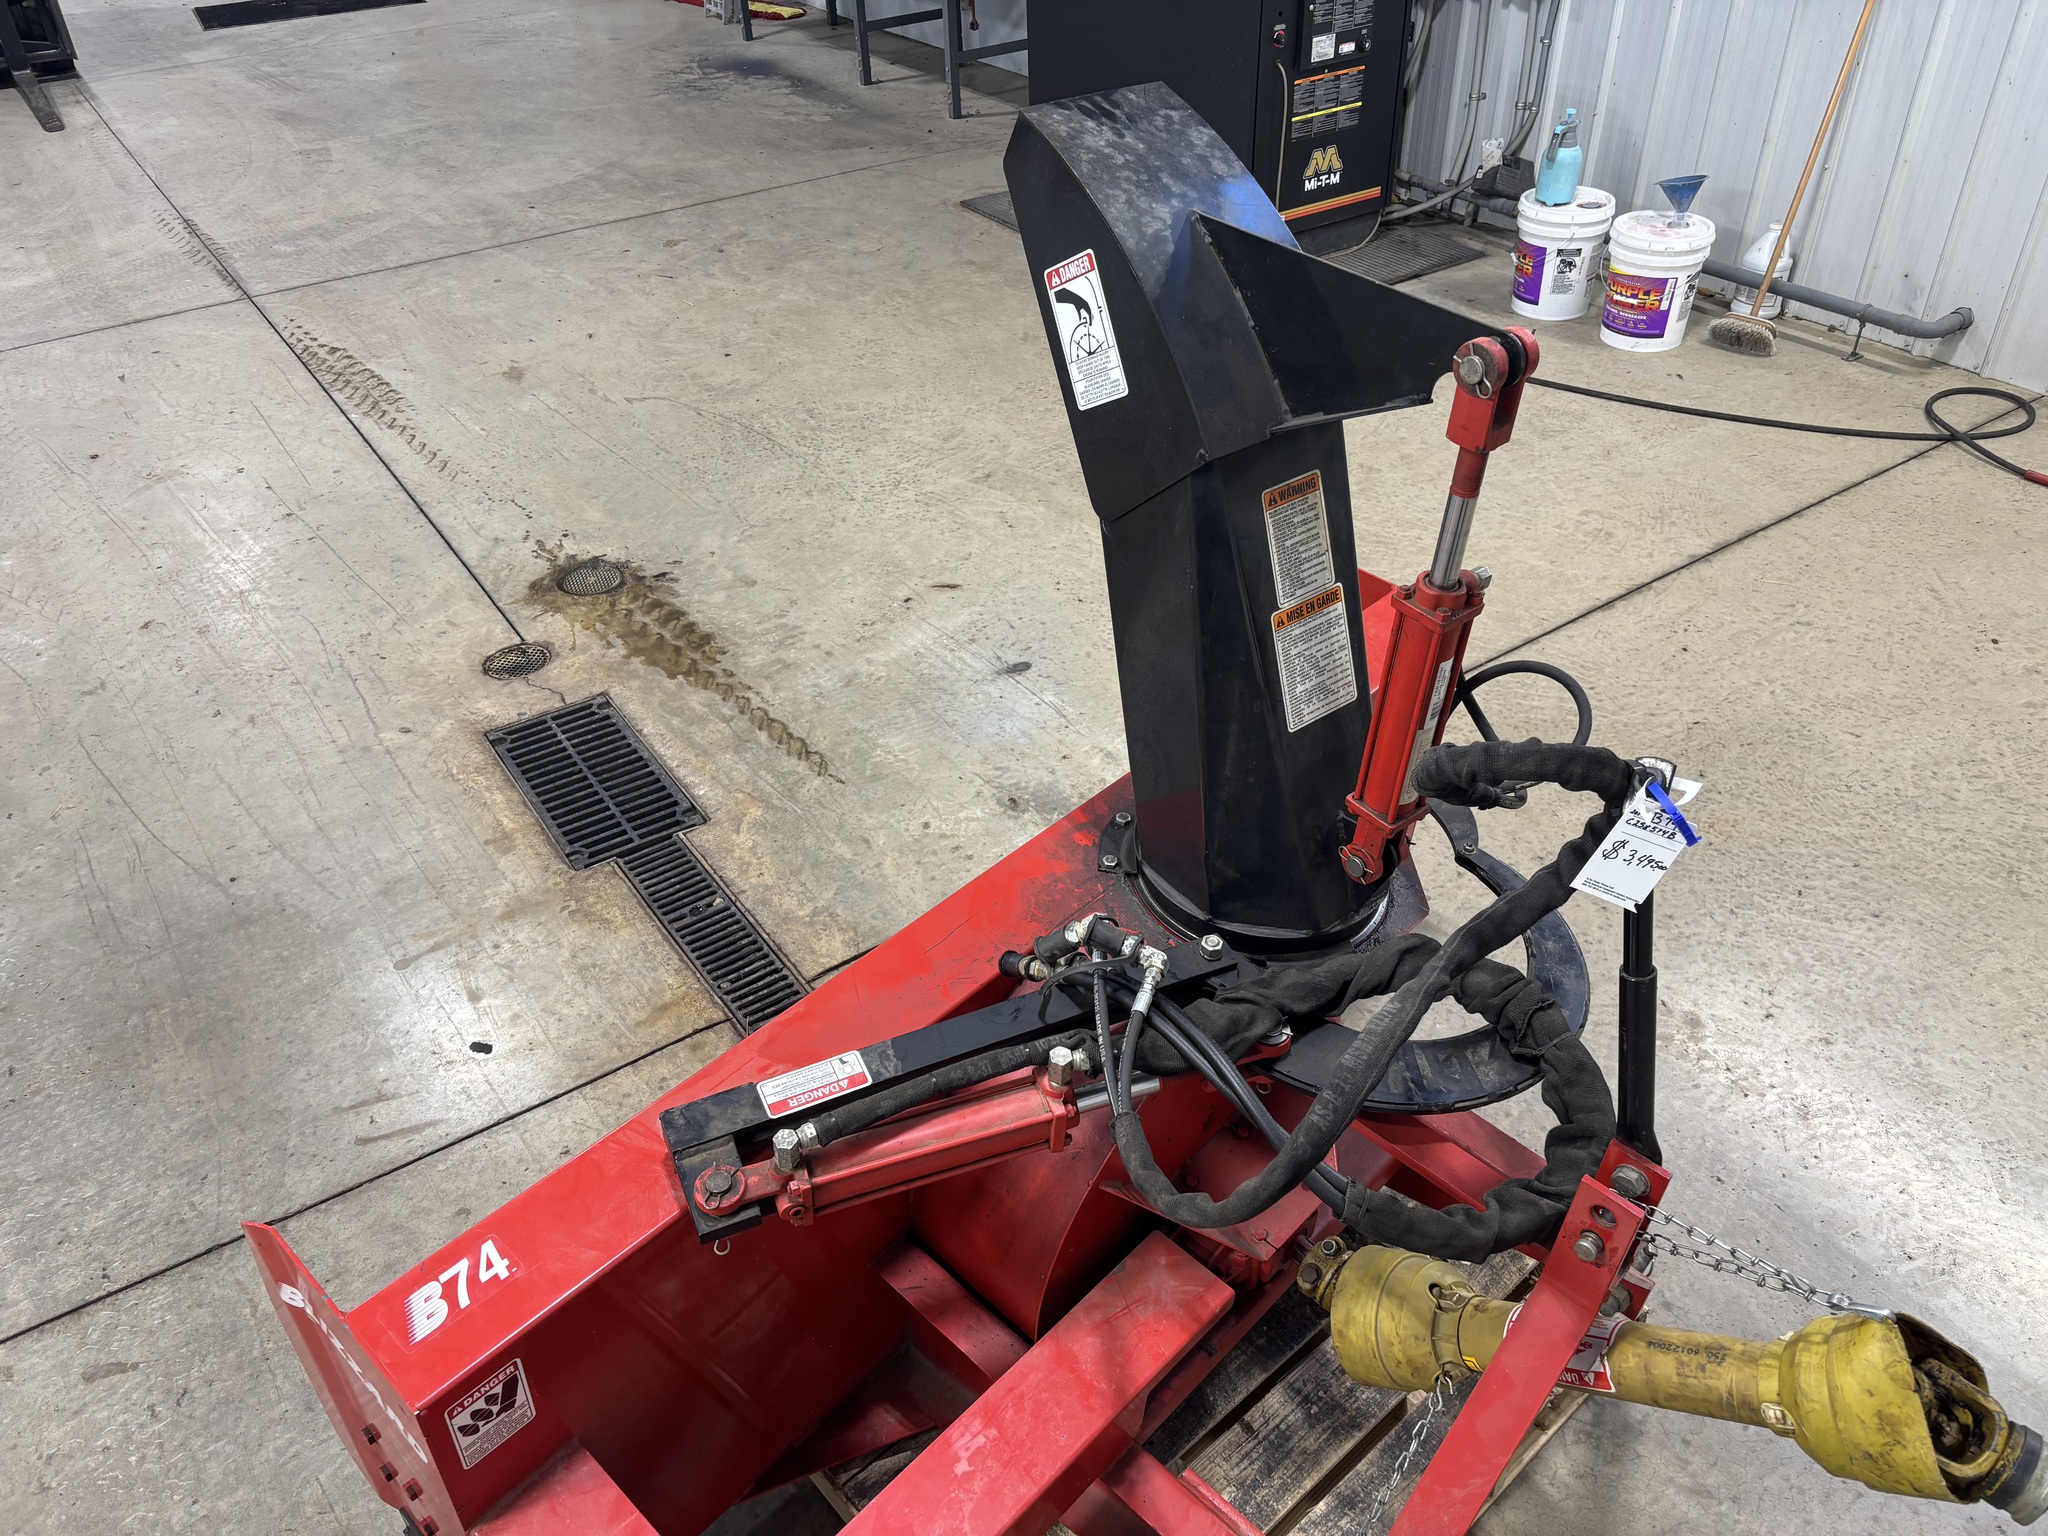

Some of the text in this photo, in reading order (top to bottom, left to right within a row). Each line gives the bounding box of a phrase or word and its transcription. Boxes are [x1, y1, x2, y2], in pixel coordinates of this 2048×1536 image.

[1304, 171, 1340, 192] Mi-T-M
[1060, 256, 1091, 280] DANGER
[1278, 478, 1316, 501] WARNING
[1286, 589, 1340, 623] MISE EN GARDE
[787, 1084, 841, 1107] DANGER
[404, 1239, 510, 1345] B74
[463, 1365, 516, 1408] DANGER
